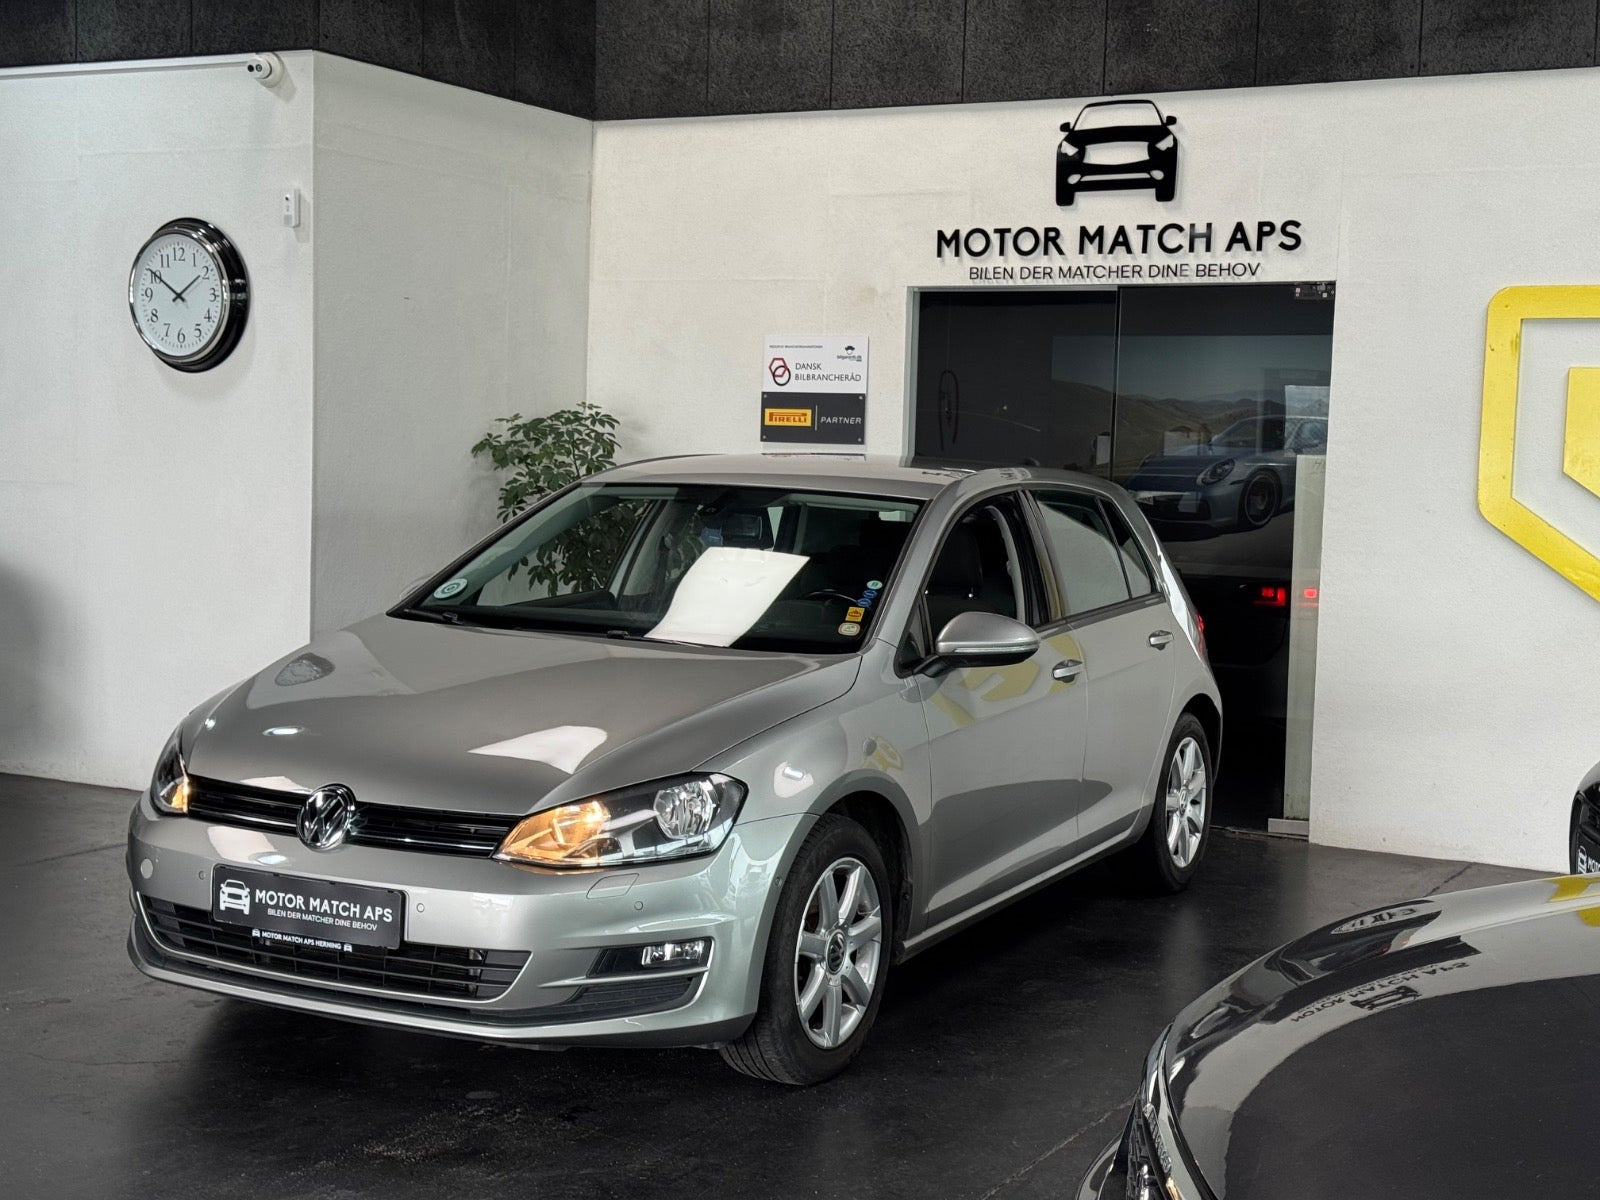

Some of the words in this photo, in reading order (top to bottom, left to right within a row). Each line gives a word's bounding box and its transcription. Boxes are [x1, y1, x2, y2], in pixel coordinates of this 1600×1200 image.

[936, 226, 1064, 258] MOTOR
[1078, 222, 1213, 255] MATCH
[1225, 219, 1303, 253] APS
[160, 254, 170, 268] 11
[172, 247, 186, 262] 12
[202, 266, 210, 280] 2
[969, 266, 1014, 280] BILEN
[1019, 265, 1053, 280] DER
[1057, 263, 1143, 279] MATCHER
[1147, 263, 1189, 278] DINE
[1195, 262, 1261, 277] BEHOV
[144, 287, 153, 303] 9
[209, 287, 217, 302] 3
[150, 308, 159, 323] 8
[204, 308, 212, 322] 4
[163, 323, 171, 338] 7
[177, 328, 186, 344] 6
[194, 323, 202, 338] 5
[795, 362, 822, 371] DANSK
[794, 372, 862, 382] BILBRANCHERÅD
[768, 412, 808, 423] PIRELLI
[820, 416, 862, 425] PARTNER
[255, 888, 306, 911] MOTOR
[309, 896, 360, 919] MATCH
[363, 905, 393, 923] APS
[267, 907, 287, 918] BILEN
[287, 911, 301, 920] DER
[302, 913, 334, 925] MATCHER
[334, 918, 351, 928] DINE
[352, 921, 378, 932] BEHOV
[261, 930, 282, 941] MOTOR
[282, 934, 302, 945] MATCH
[303, 938, 315, 946] APS
[315, 940, 342, 951] HERNING
